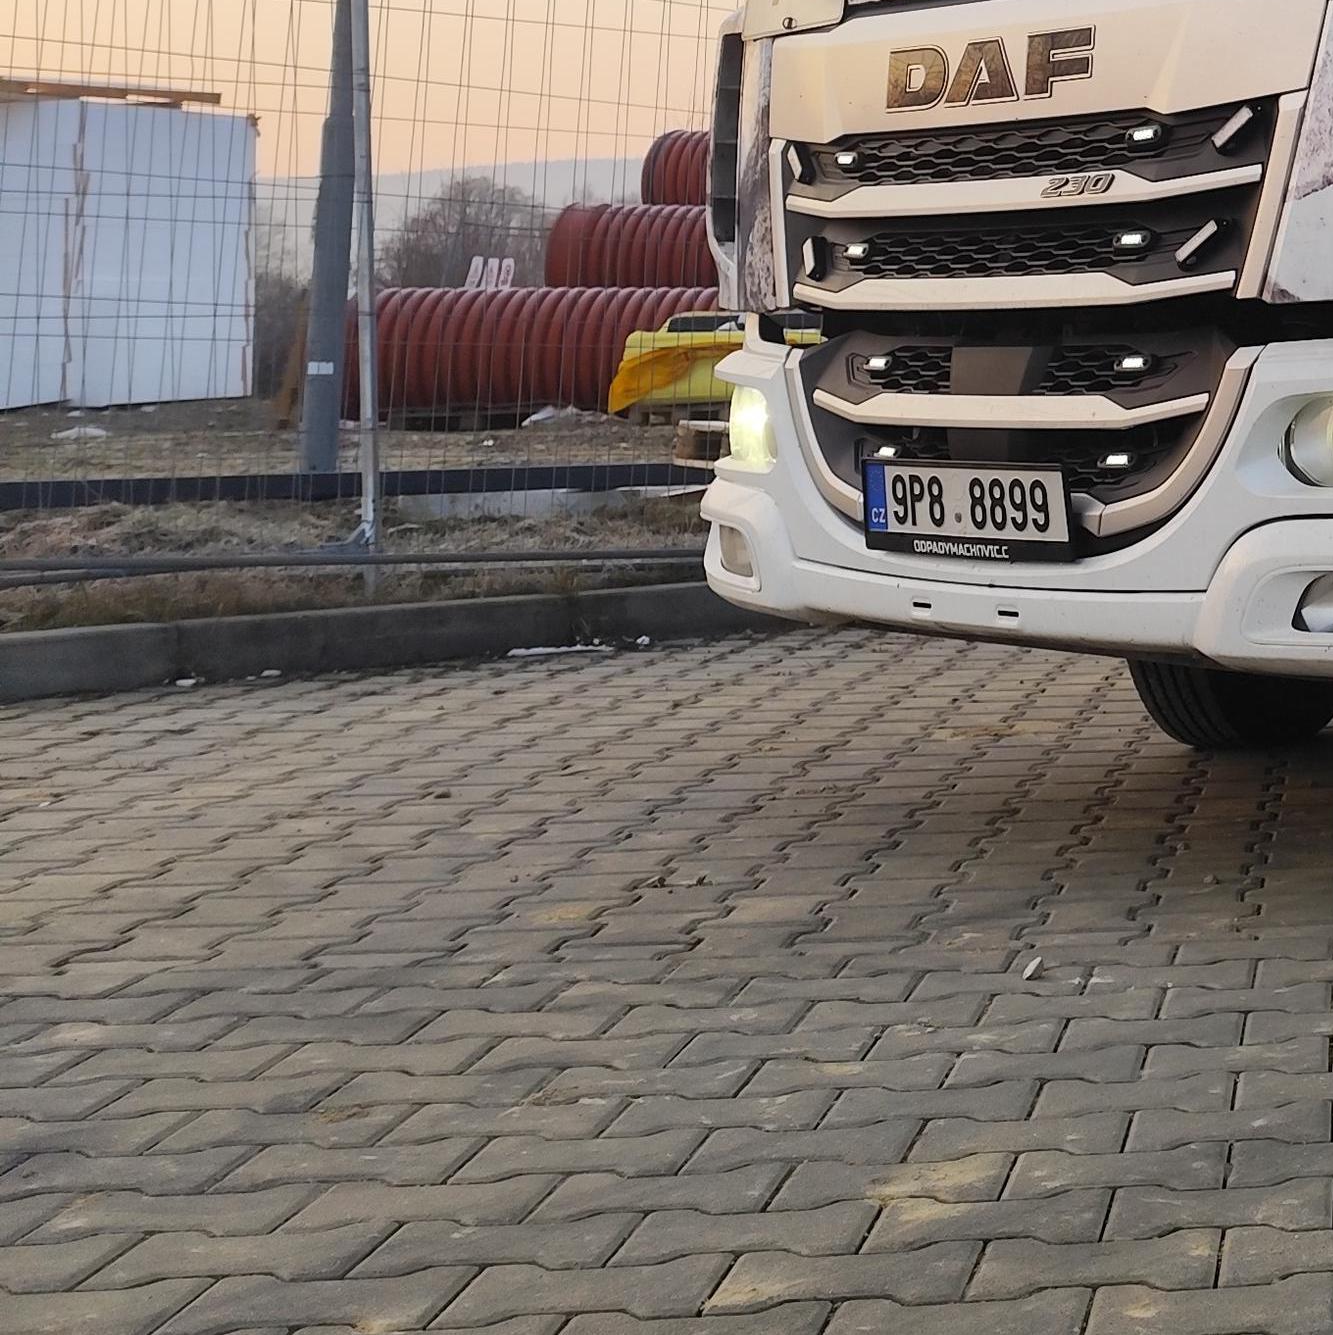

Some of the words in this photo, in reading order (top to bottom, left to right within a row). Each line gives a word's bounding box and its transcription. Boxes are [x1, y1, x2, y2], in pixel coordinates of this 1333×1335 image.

[885, 24, 1096, 114] DAF
[1040, 173, 1114, 198] 230
[871, 507, 886, 524] CZ
[891, 473, 945, 528] 9P8
[969, 476, 1050, 534] 8899
